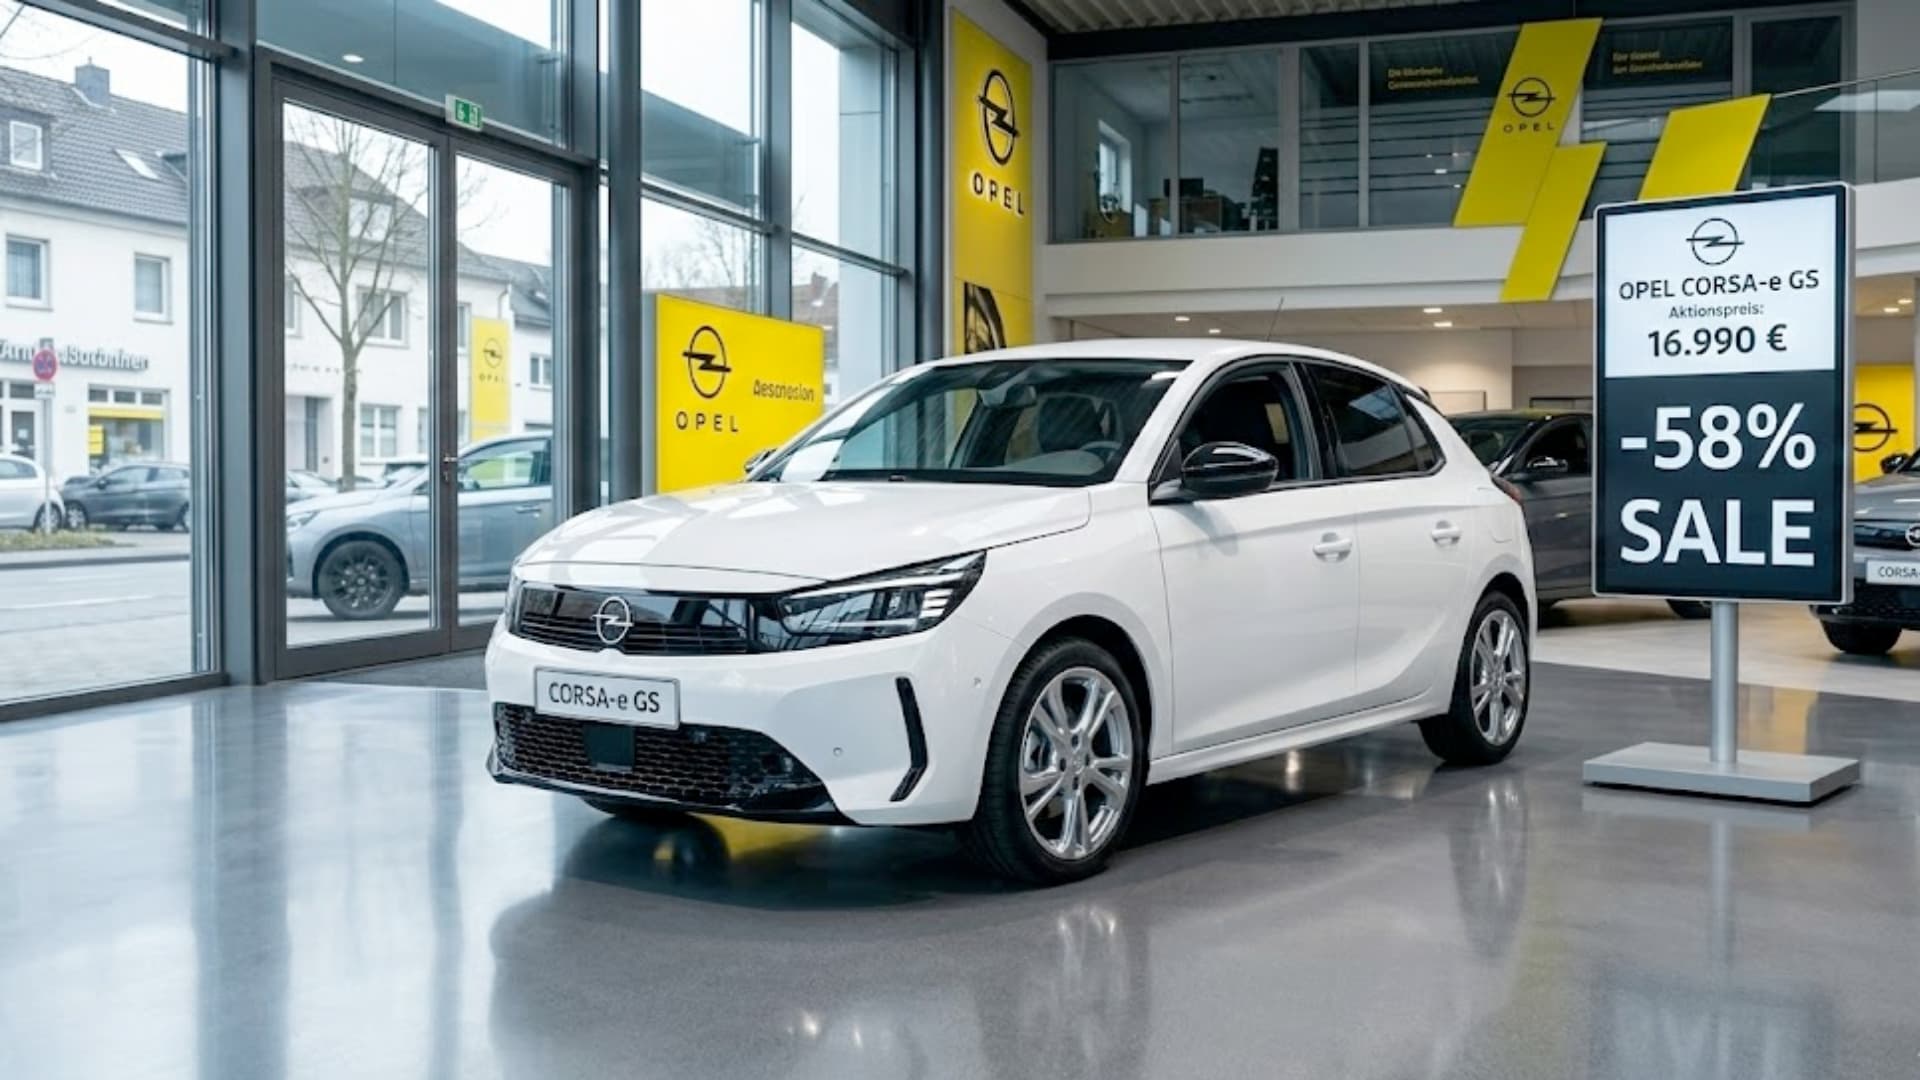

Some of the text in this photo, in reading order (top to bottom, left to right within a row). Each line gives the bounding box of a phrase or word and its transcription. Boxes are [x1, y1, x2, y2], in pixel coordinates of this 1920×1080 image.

[1503, 122, 1554, 133] OPEL
[972, 171, 1025, 215] OPEL
[1618, 269, 1819, 300] OPEL CORSA-e GS
[1668, 302, 1764, 319] Aktionspreis:
[1648, 323, 1788, 357] 16.990 €
[676, 411, 739, 432] OPEL
[1620, 402, 1817, 470] -58%
[1620, 498, 1816, 567] SALE
[548, 682, 660, 713] CORSA-e GS
